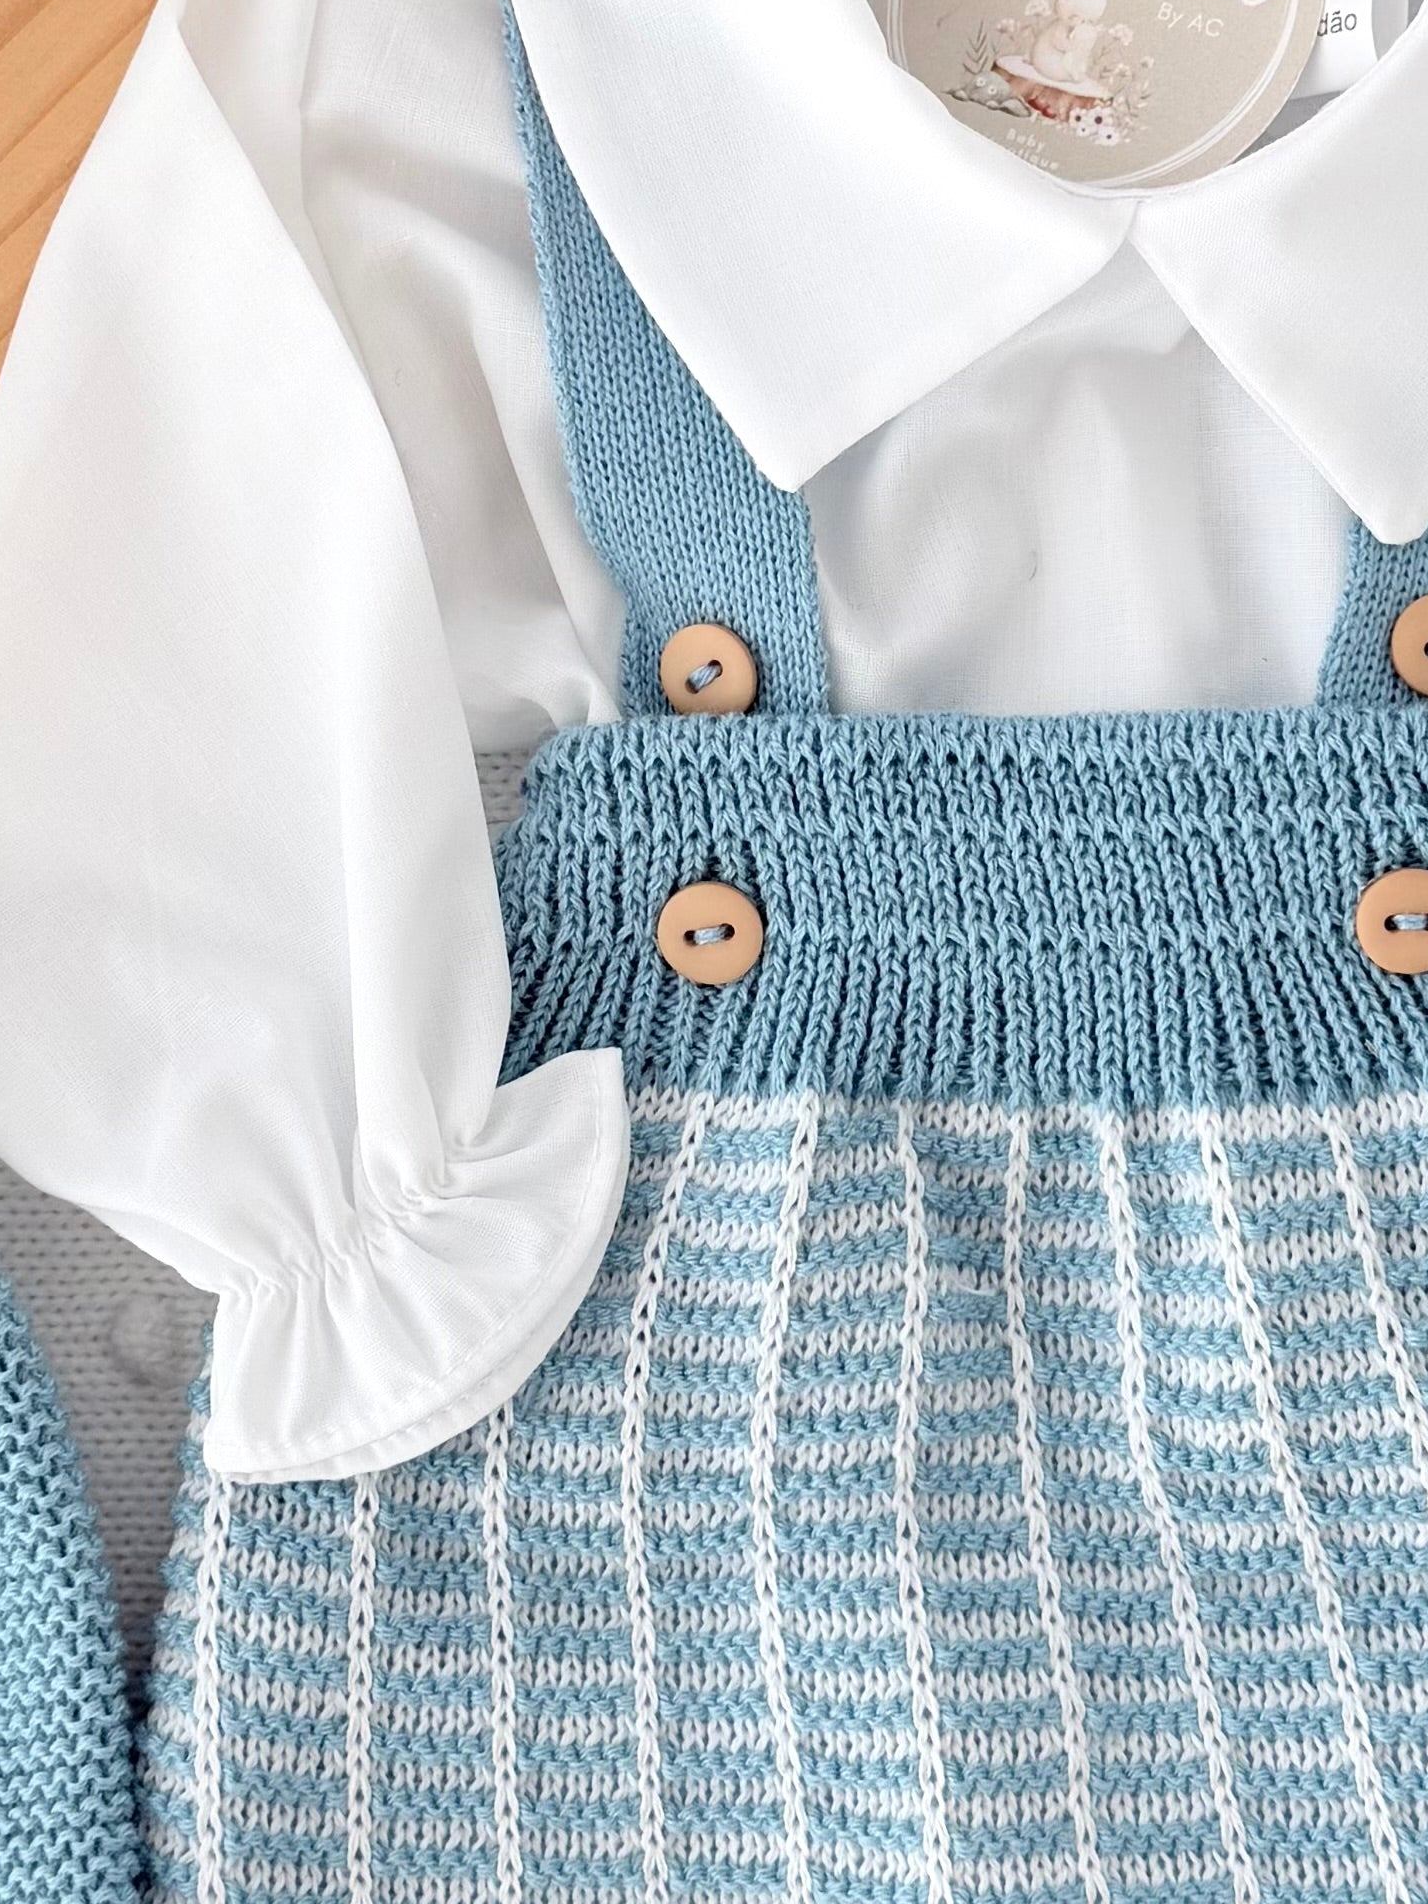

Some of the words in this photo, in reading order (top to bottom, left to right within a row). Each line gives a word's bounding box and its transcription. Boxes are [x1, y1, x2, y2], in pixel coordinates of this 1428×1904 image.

[1157, 2, 1183, 28] By
[1188, 14, 1224, 37] AC
[1316, 10, 1358, 37] dão
